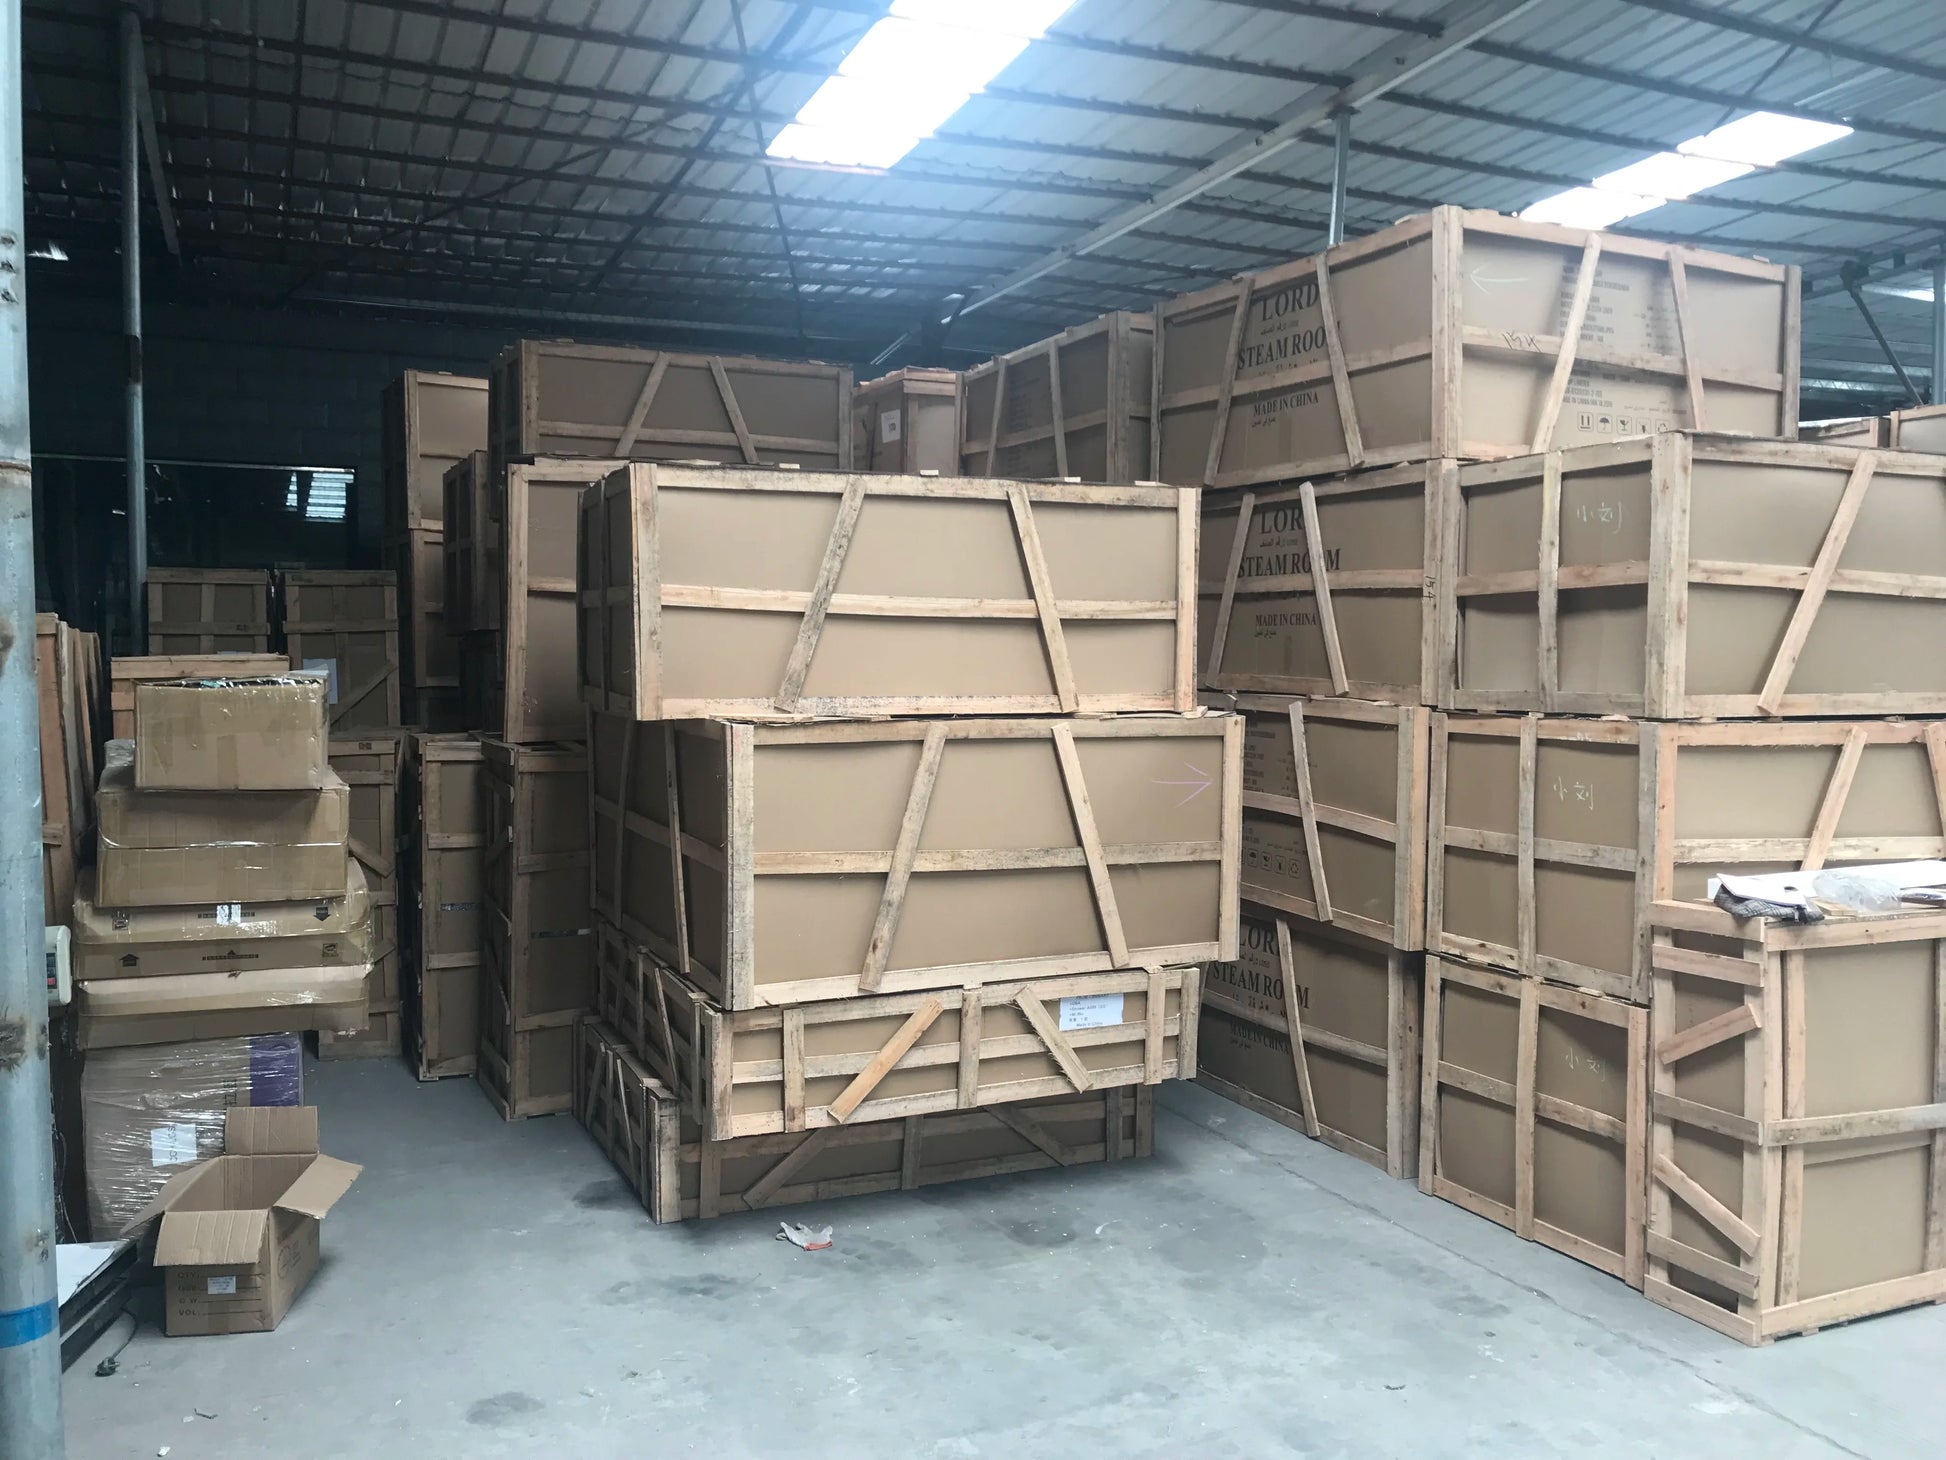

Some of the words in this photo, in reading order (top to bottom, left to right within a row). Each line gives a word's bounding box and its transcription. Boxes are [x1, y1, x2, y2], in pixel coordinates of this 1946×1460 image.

[1261, 283, 1319, 321] LORD
[1237, 336, 1288, 370] STEAM
[1292, 321, 1340, 356] ROO
[1253, 401, 1277, 417] MADE
[1278, 399, 1289, 411] IN
[1289, 391, 1319, 409] CHINA
[1260, 507, 1304, 535] LOR
[1237, 554, 1288, 578] STEAM
[1292, 548, 1341, 574] ROM
[1255, 614, 1278, 627] MADE
[1279, 613, 1289, 626] IN
[1289, 612, 1317, 626] CHINA
[1240, 926, 1280, 957] OR
[1213, 961, 1260, 994] STEAM
[1263, 974, 1310, 1010] ROM
